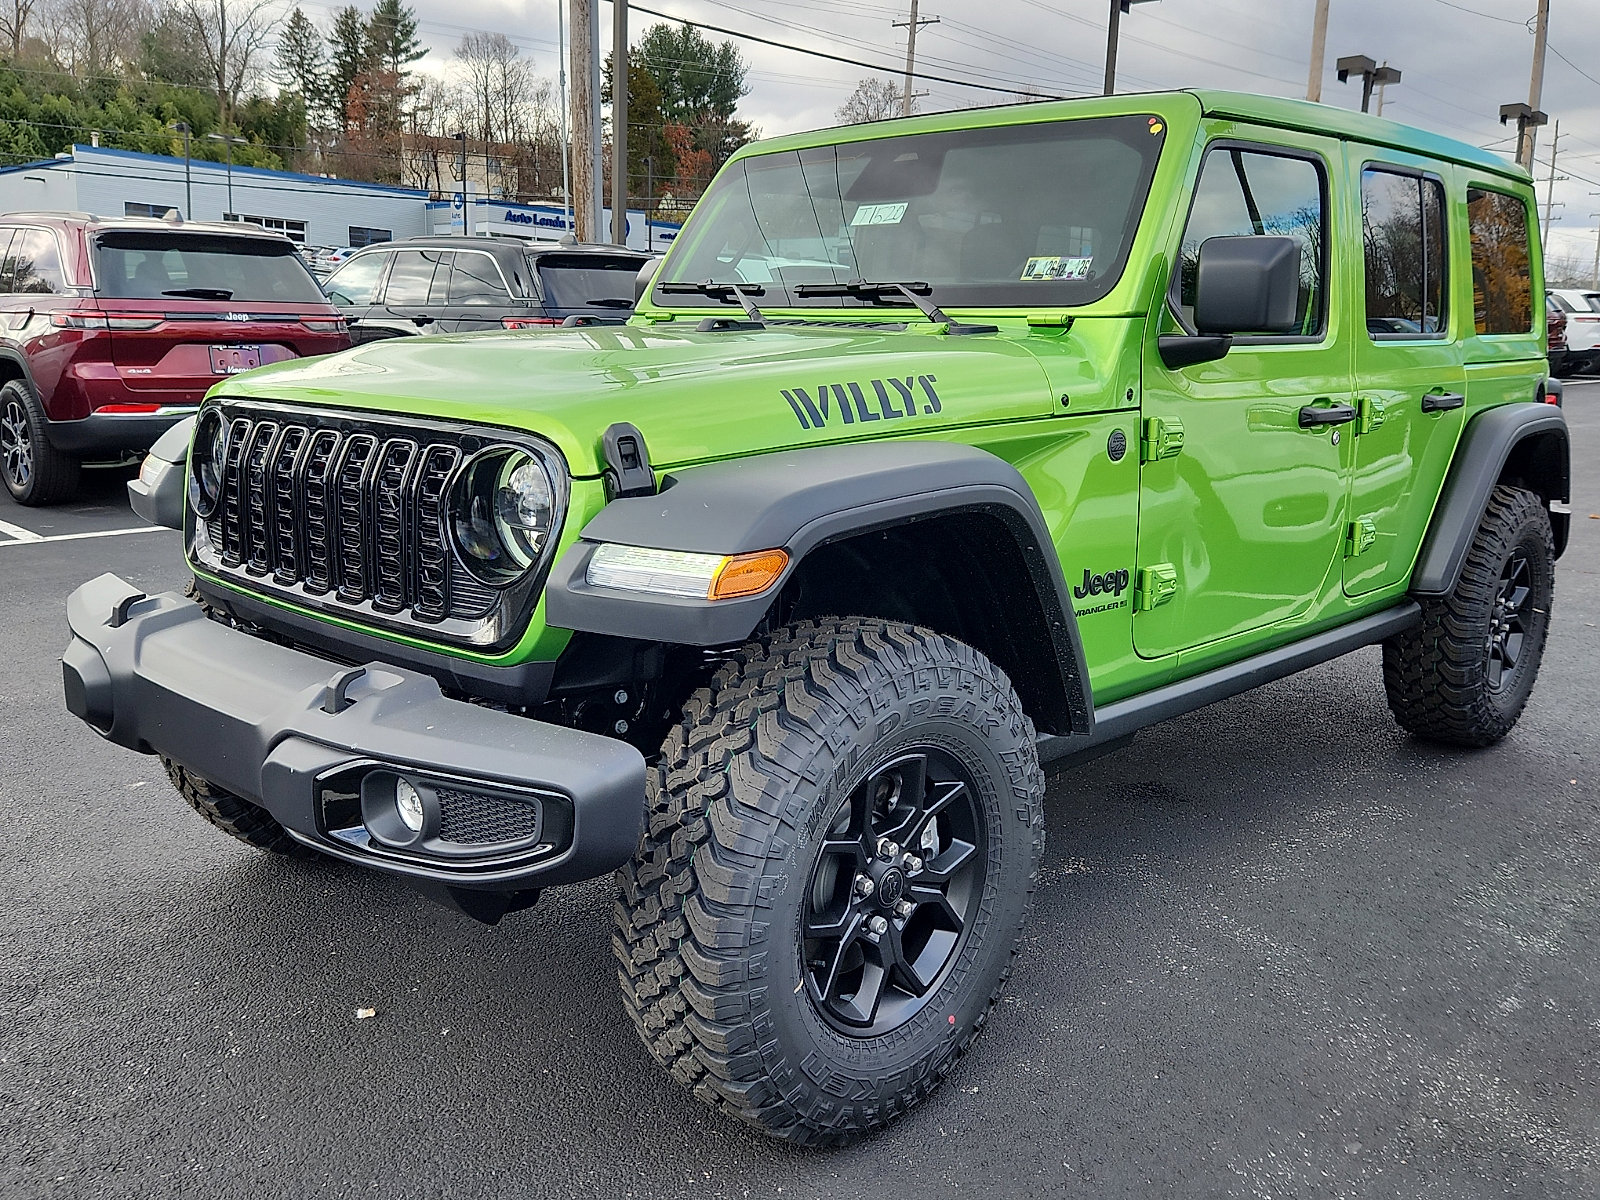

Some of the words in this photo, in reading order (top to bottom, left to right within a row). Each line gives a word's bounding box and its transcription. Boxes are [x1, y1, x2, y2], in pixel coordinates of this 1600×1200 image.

[505, 210, 532, 224] Auto
[226, 311, 249, 322] Jeep
[780, 374, 942, 429] WILLYS
[1073, 568, 1129, 599] Jeep
